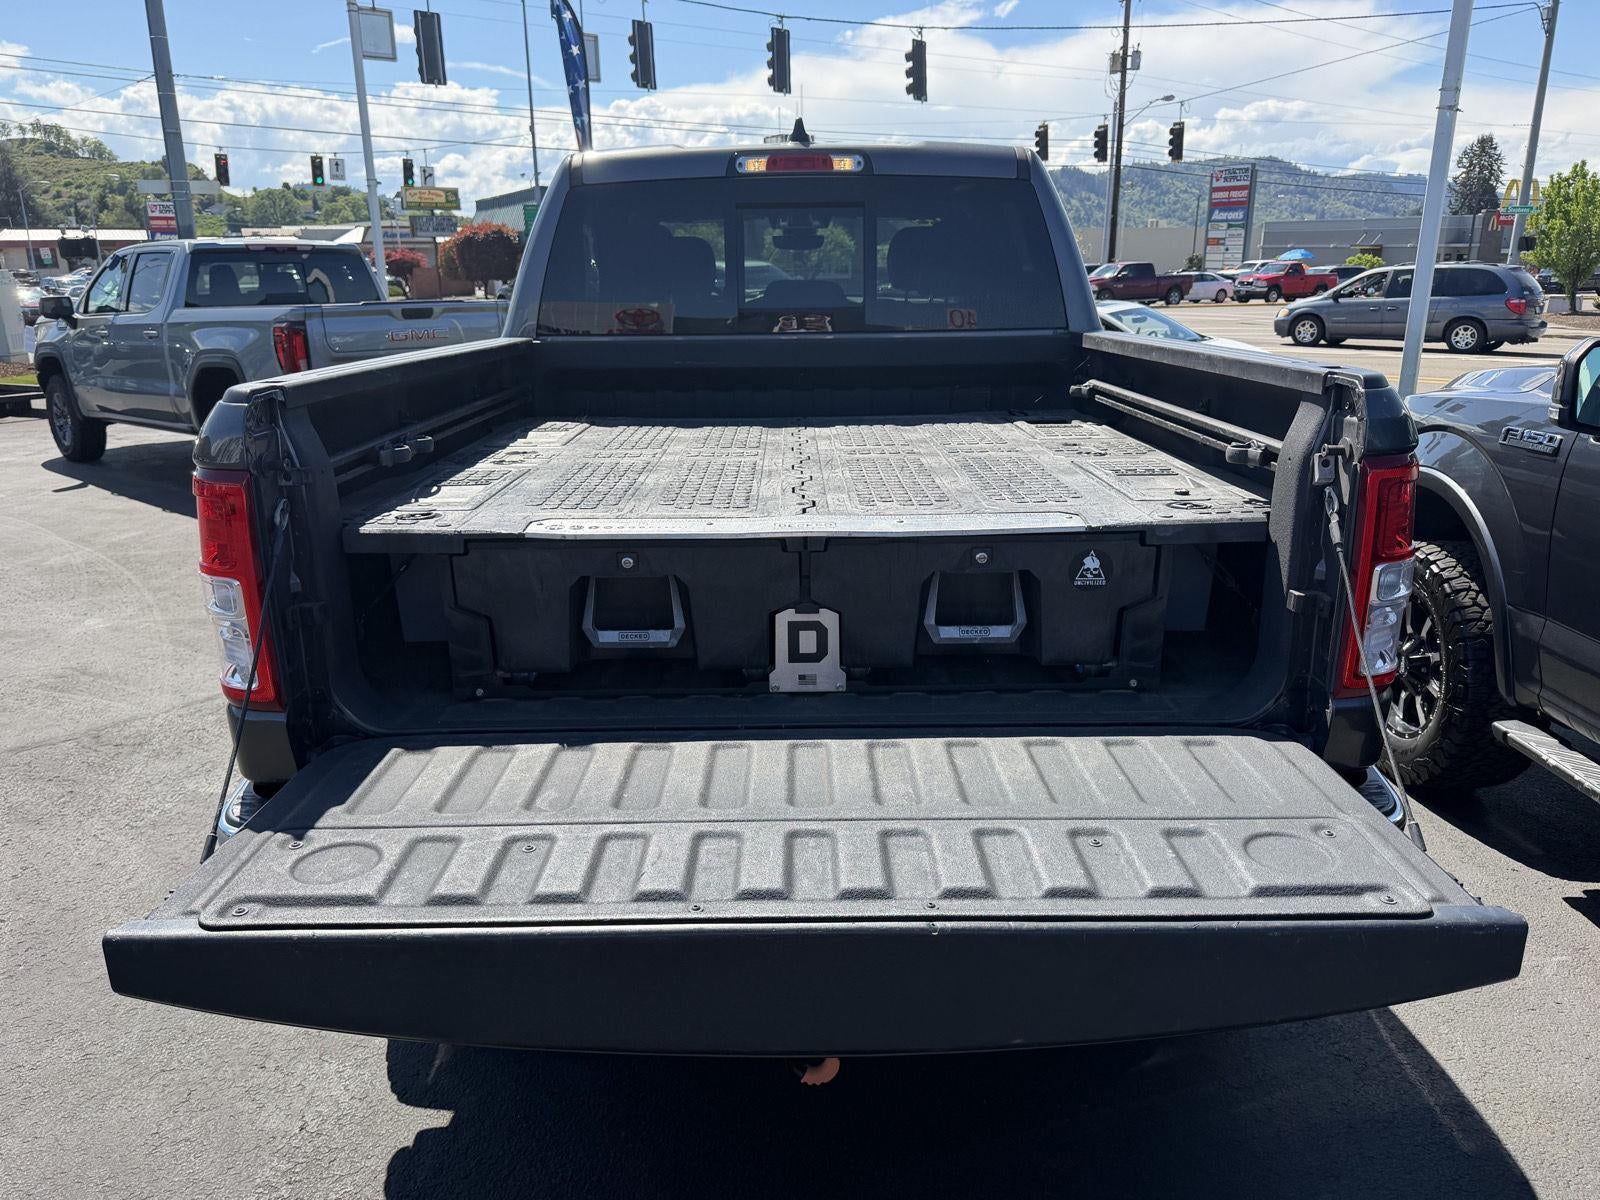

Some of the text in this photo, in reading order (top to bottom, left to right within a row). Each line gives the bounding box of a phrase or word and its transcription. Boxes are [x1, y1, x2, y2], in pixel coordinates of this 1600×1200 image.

[1211, 210, 1245, 220] Aaron's
[387, 328, 449, 343] GMC
[787, 620, 829, 664] D
